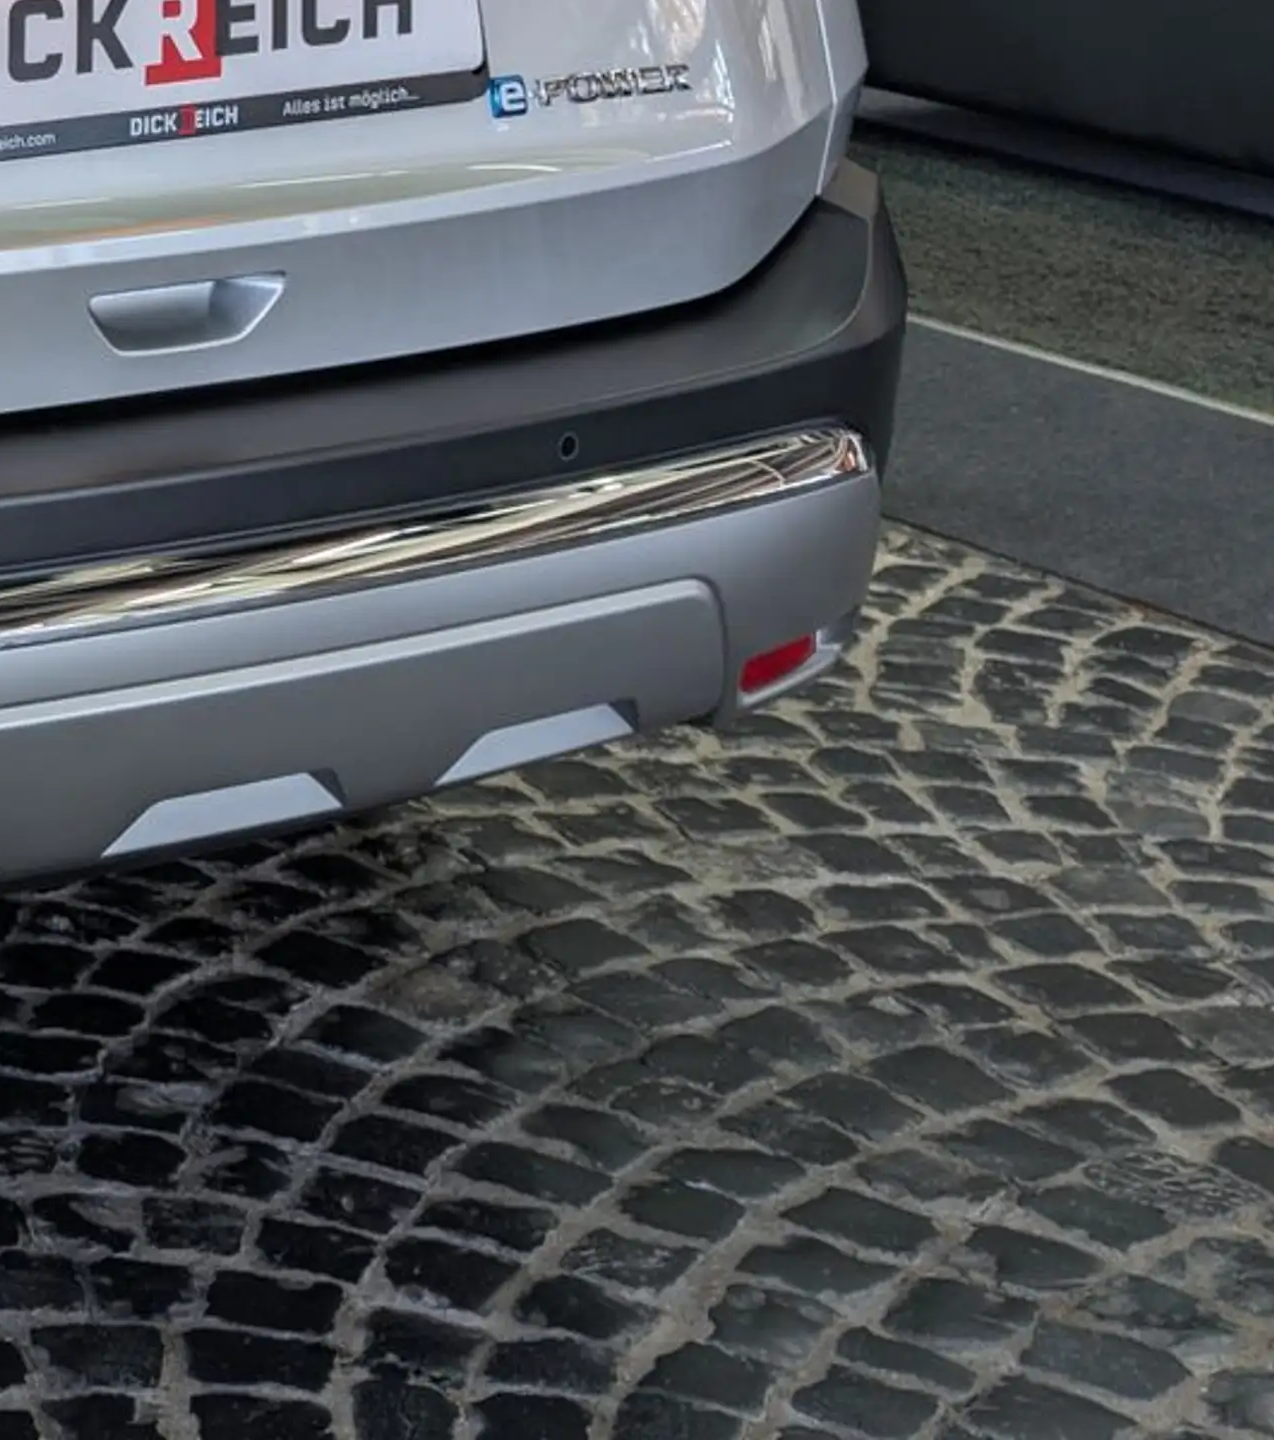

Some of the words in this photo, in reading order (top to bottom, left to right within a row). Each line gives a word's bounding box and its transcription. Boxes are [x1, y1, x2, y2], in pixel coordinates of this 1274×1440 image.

[283, 96, 321, 117] Alles
[324, 93, 346, 111] ist
[129, 104, 239, 137] DICKEICH
